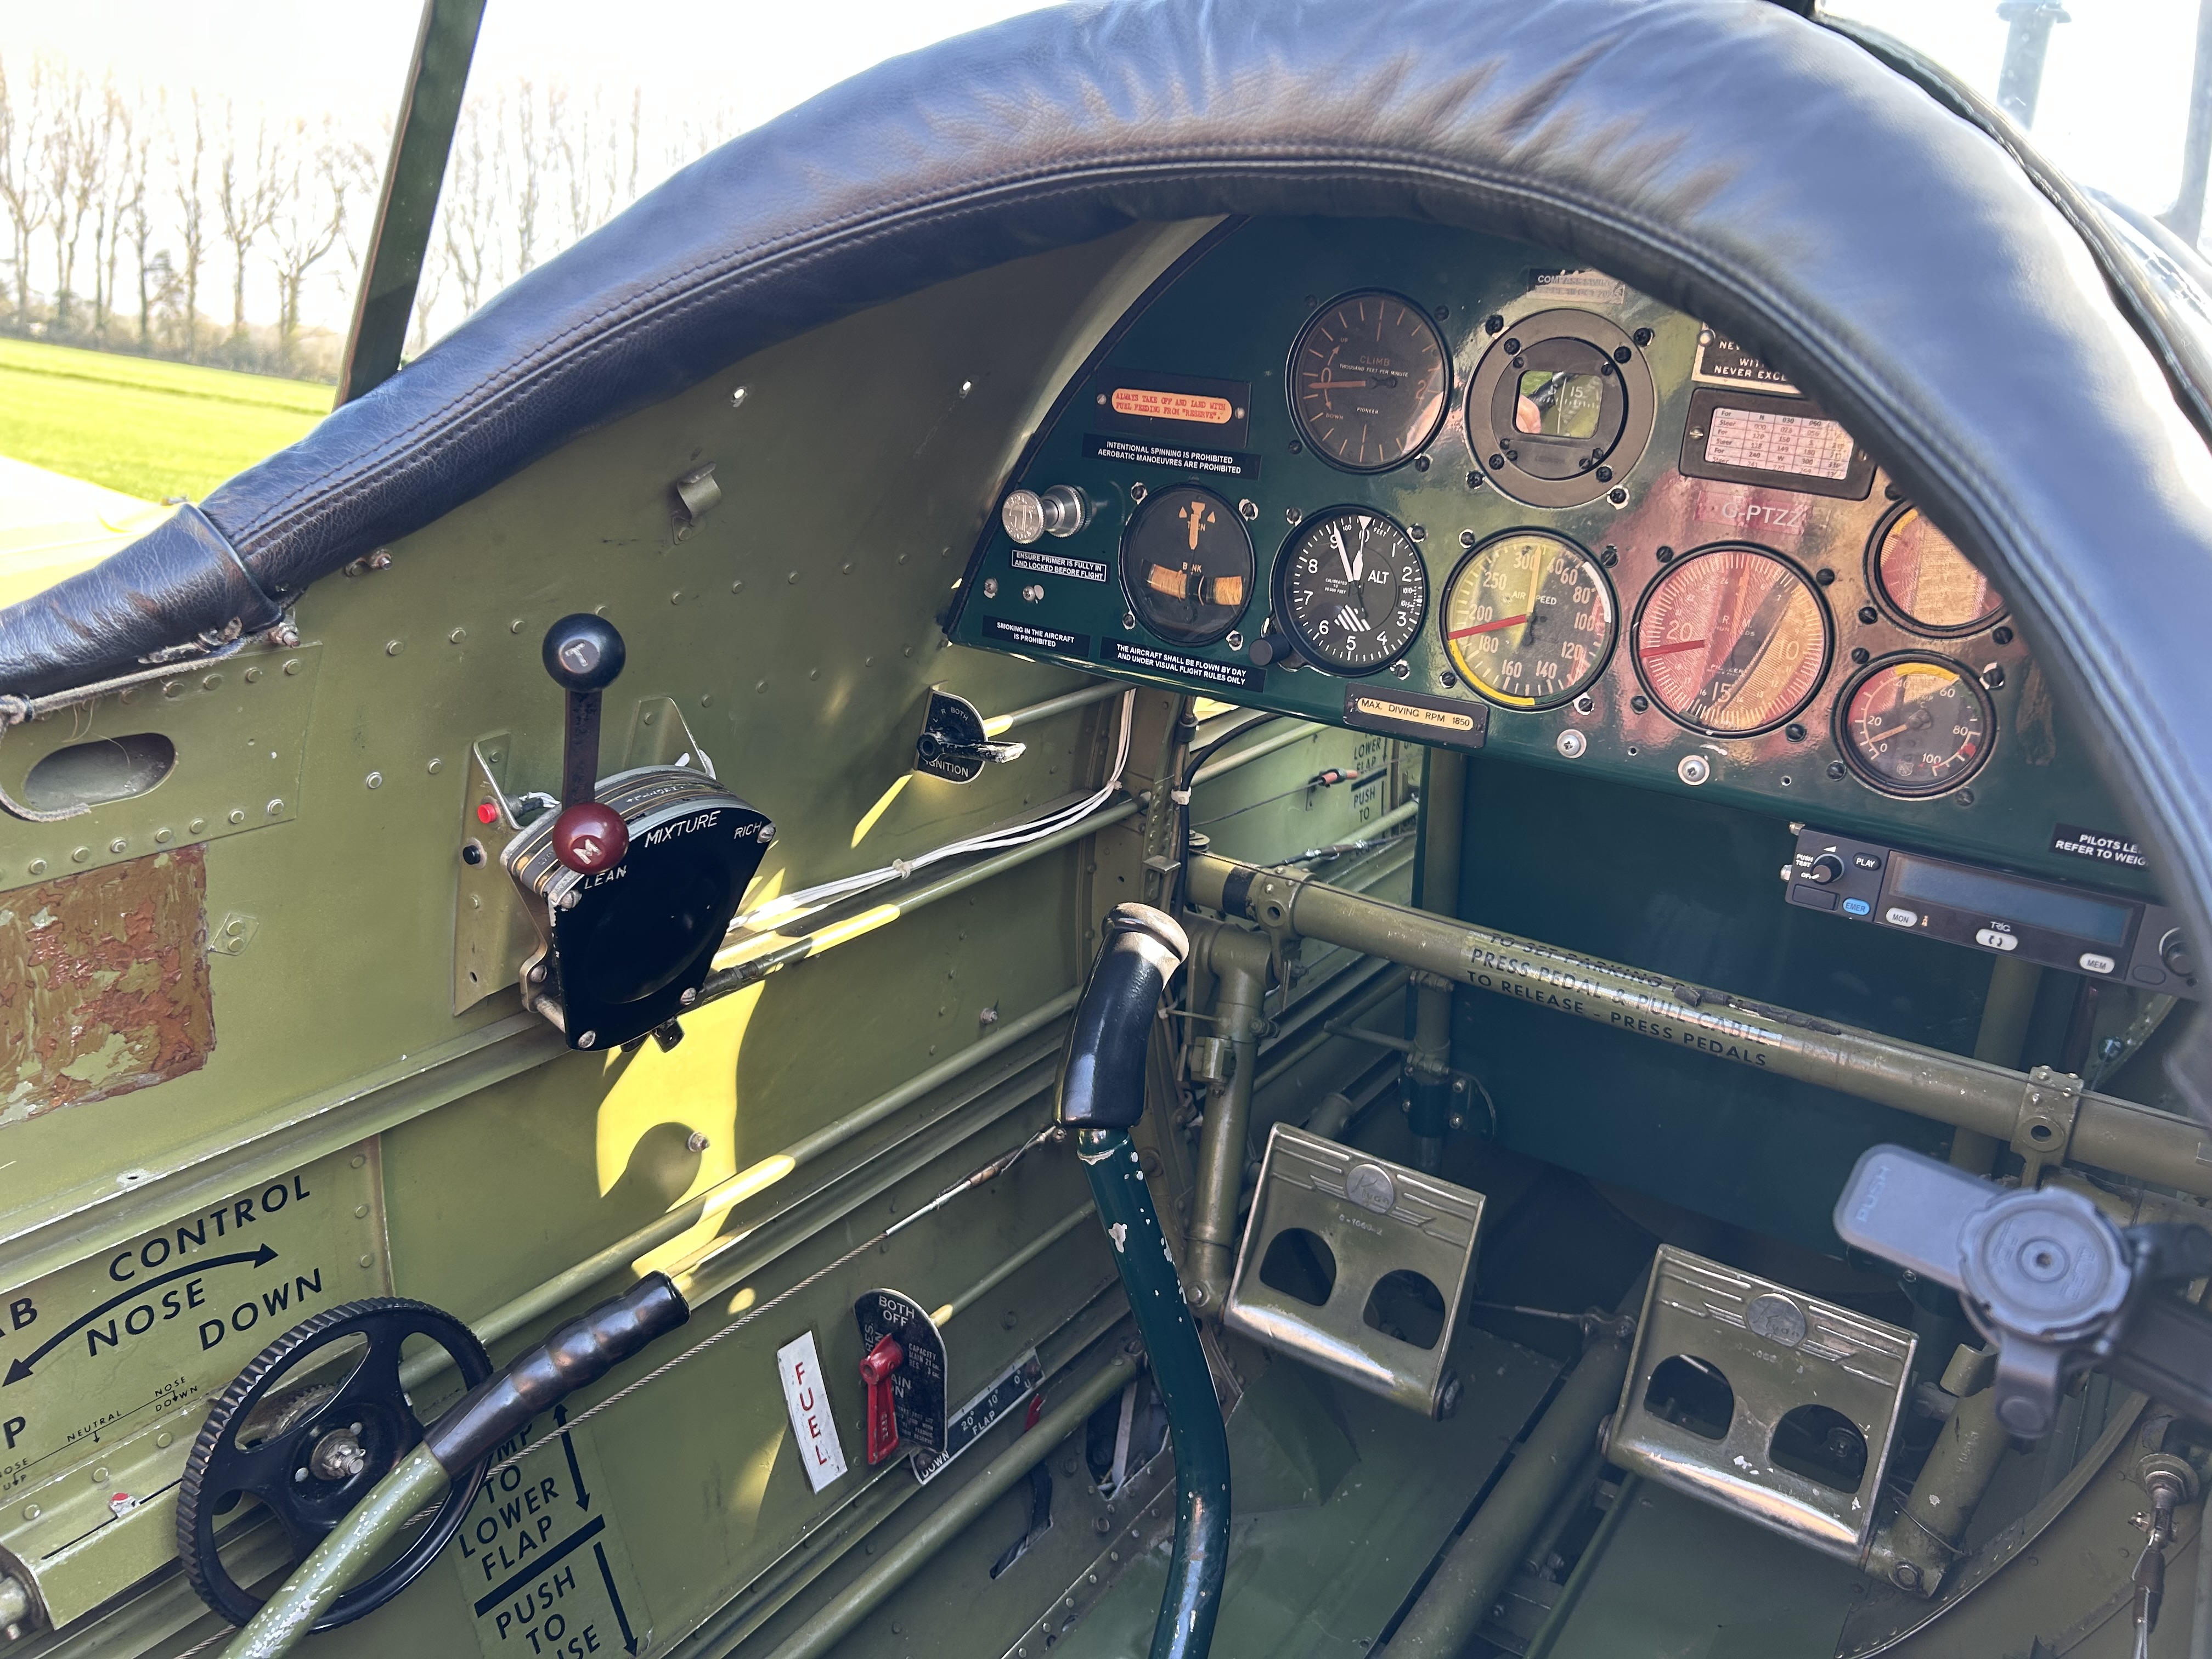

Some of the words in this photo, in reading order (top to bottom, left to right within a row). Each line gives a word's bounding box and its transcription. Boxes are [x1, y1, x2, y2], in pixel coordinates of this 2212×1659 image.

[1340, 363, 1364, 371] THOUSAND
[1361, 356, 1390, 366] CLIMB
[1714, 365, 1752, 377] NEVER
[1415, 380, 1426, 400] 2
[1116, 392, 1138, 401] ALWAYS
[1191, 400, 1206, 409] LAND
[1210, 402, 1226, 411] WITH
[1116, 402, 1131, 410] FUEL
[1135, 404, 1160, 414] FEEDING
[1098, 448, 1135, 460] AEROBATIC
[1136, 455, 1182, 467] MANOEUVRES
[1183, 461, 1198, 469] ARE
[1199, 462, 1241, 474] PROHIBITED
[1107, 441, 1149, 453] INTENTIONAL
[1151, 448, 1182, 458] SPINNING
[1191, 453, 1233, 464] PROHIBITED
[1722, 502, 1802, 527] G-PTZZ
[1330, 534, 1339, 549] 9
[1373, 527, 1387, 537] FEET
[1015, 560, 1028, 568] AND
[1029, 562, 1053, 572] LOCKED
[1054, 566, 1079, 575] BEFORE
[1081, 570, 1103, 580] FLIGHT
[1017, 552, 1040, 562] ENSURE
[1042, 556, 1065, 566] PRIMER
[1074, 562, 1093, 570] FULLY
[1308, 559, 1318, 573] 8
[1547, 558, 1564, 575] 40
[1368, 569, 1390, 584] ALT
[1402, 566, 1412, 582] 2
[1483, 572, 1507, 590] 250
[1560, 568, 1578, 585] 60
[1304, 590, 1313, 605] 7
[1511, 590, 1526, 600] AIR
[1572, 586, 1591, 604] 80
[1396, 611, 1407, 627] 3
[1469, 603, 1493, 622] 200
[1574, 612, 1595, 631] 100
[997, 622, 1023, 633] SMOKING
[1031, 629, 1043, 637] THE
[1044, 631, 1074, 643] AIRCRAFT
[1319, 620, 1329, 635] 6
[1666, 620, 1694, 642] 20
[1020, 634, 1056, 647] PROHIBITED
[1346, 635, 1356, 651] 5
[1376, 631, 1387, 646] 4
[1479, 635, 1499, 653] 180
[565, 642, 589, 668] T
[1561, 641, 1584, 660] 120
[1777, 640, 1799, 661] 10
[1117, 644, 1129, 653] THE
[1130, 647, 1162, 660] AIRCRAFT
[1163, 654, 1184, 664] SHALL
[1186, 658, 1194, 667] BE
[1195, 661, 1220, 672] FLOWN
[1232, 668, 1246, 677] DAY
[1118, 652, 1131, 661] AND
[1132, 655, 1154, 666] UNDER
[1155, 661, 1178, 672] VISUAL
[1180, 665, 1203, 676] FLIGHT
[1204, 671, 1226, 681] RULES
[1227, 676, 1246, 685] ONLY
[1502, 659, 1522, 678] 160
[1536, 660, 1558, 679] 140
[1712, 681, 1732, 703] 15
[1939, 688, 1955, 698] 60
[951, 707, 969, 721] BOTH
[1361, 699, 1383, 710] MAX.
[1389, 704, 1420, 717] DIVING
[1425, 712, 1445, 723] RPM
[1452, 716, 1470, 726] 1850
[1867, 716, 1882, 726] 20
[1953, 725, 1968, 736] 80
[1354, 737, 1381, 760] LOWER
[1880, 743, 1888, 752] 0
[1922, 753, 1942, 764] 100
[1354, 786, 1375, 809] PUSH
[1359, 806, 1370, 822] TO
[644, 810, 721, 848] MIXTURE
[734, 821, 763, 840] RICH
[2055, 840, 2094, 856] REFER
[2096, 849, 2112, 859] TO
[2079, 834, 2121, 850] PILOTS
[573, 839, 602, 865] M
[1796, 853, 1814, 862] PUSH
[1796, 860, 1812, 868] TEST
[1856, 857, 1876, 868] PLAY
[584, 865, 628, 890] LEAN
[1846, 902, 1866, 912] EMER
[1892, 913, 1909, 924] MON
[1990, 921, 2011, 932] TRIG
[2086, 959, 2107, 970] MEM
[1471, 948, 1530, 977] PRESS
[1538, 967, 1601, 998] PEDAL
[1611, 988, 1625, 1006] &
[1637, 994, 1685, 1023] PULL
[1697, 1012, 1769, 1045] CABLE
[1467, 970, 1492, 986] TO
[1501, 980, 1583, 1014] RELEASE
[1611, 1011, 1673, 1039] PRESS
[1684, 1032, 1765, 1066] PEDALS
[109, 1175, 311, 1282] CONTROL
[198, 1268, 323, 1351] DOWN
[879, 1295, 915, 1319] BOTH
[86, 1278, 206, 1357] NOSE
[883, 1310, 909, 1327] OFF
[909, 1343, 936, 1360] CAPACITY
[909, 1351, 924, 1363] MAIN
[925, 1358, 932, 1367] 21
[155, 1376, 187, 1397] NOSE
[155, 1385, 198, 1412] DOWN
[988, 1389, 999, 1407] 10°
[795, 1361, 827, 1465] FUEL
[961, 1410, 975, 1431] 20°
[972, 1410, 996, 1435] FLAP
[67, 1410, 122, 1442] NEUTRAL
[922, 1450, 950, 1479] DOWN
[3, 1474, 26, 1491] UP
[482, 1465, 521, 1504] TO
[458, 1476, 560, 1559] LOWER
[481, 1514, 553, 1581] FLAP
[495, 1565, 577, 1640] PUSH
[525, 1613, 566, 1655] TO
